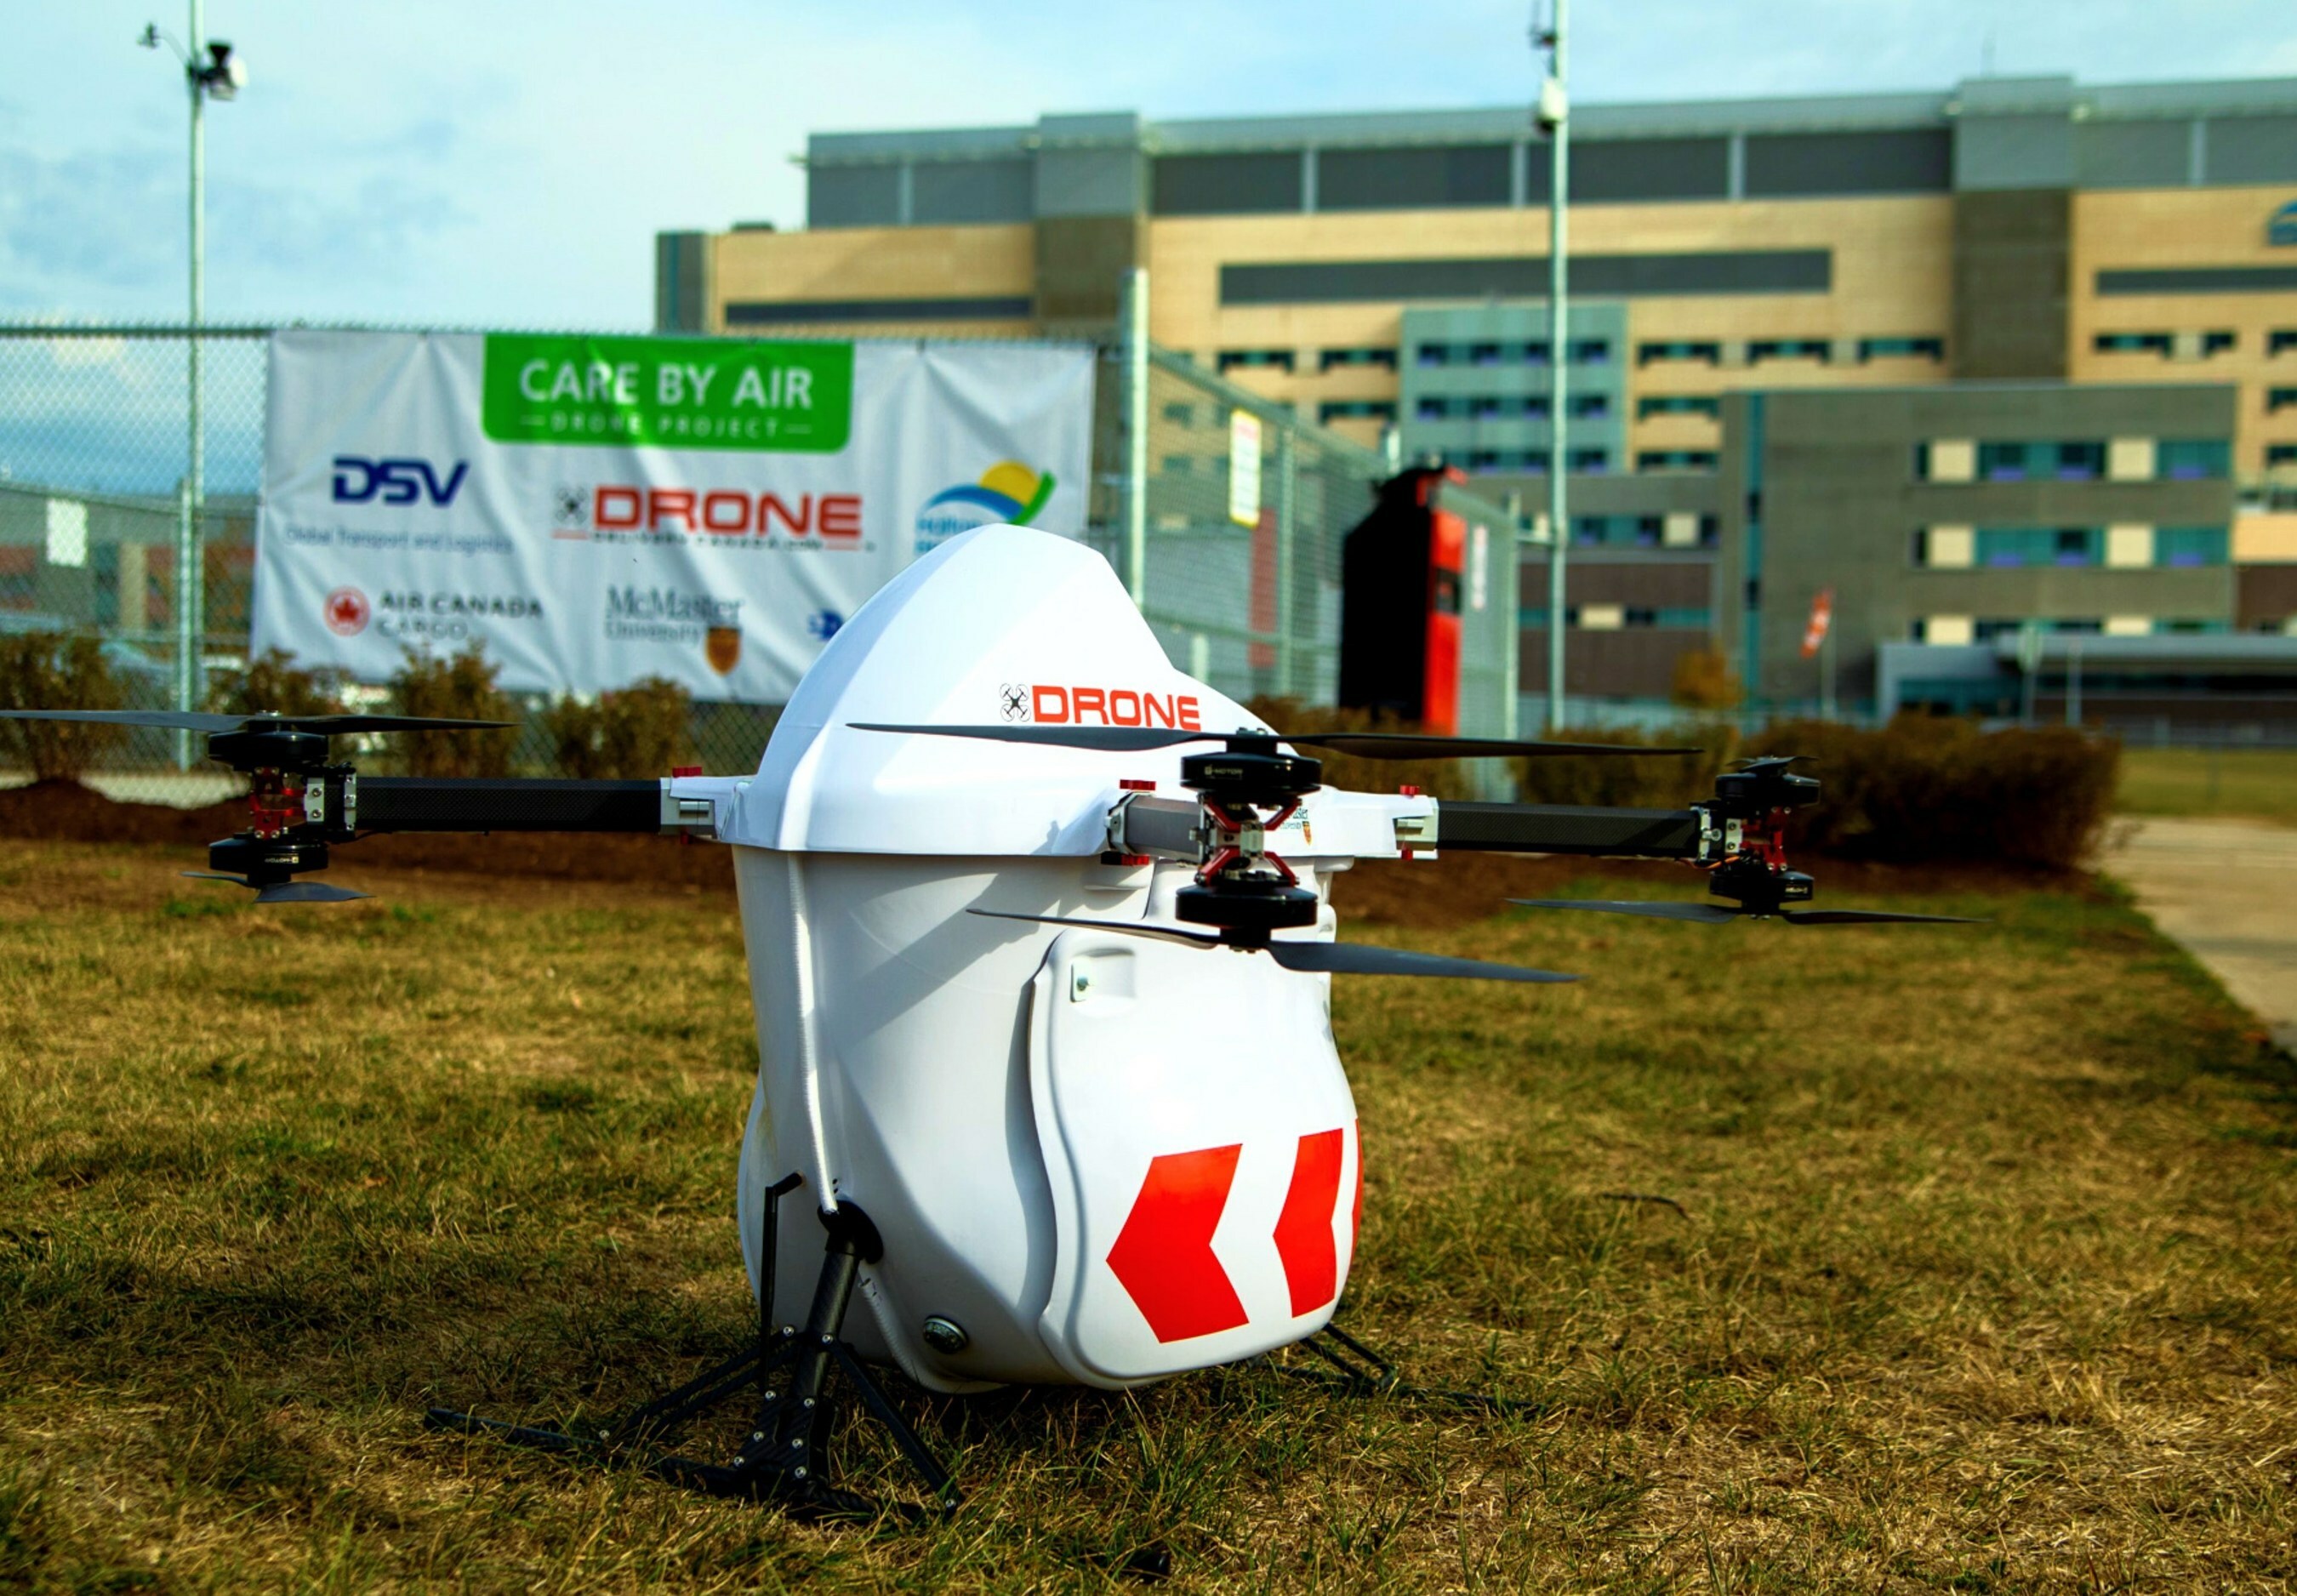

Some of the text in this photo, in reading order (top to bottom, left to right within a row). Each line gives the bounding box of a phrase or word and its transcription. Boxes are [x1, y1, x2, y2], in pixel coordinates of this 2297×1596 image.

[519, 357, 813, 410] CARE BY AIR
[550, 409, 780, 439] DRONE PROJECT
[333, 458, 468, 507] DSV
[593, 486, 863, 539] DRONE
[429, 593, 543, 618] CANADA
[605, 584, 743, 620] McMaster
[1032, 685, 1201, 732] DRONE
